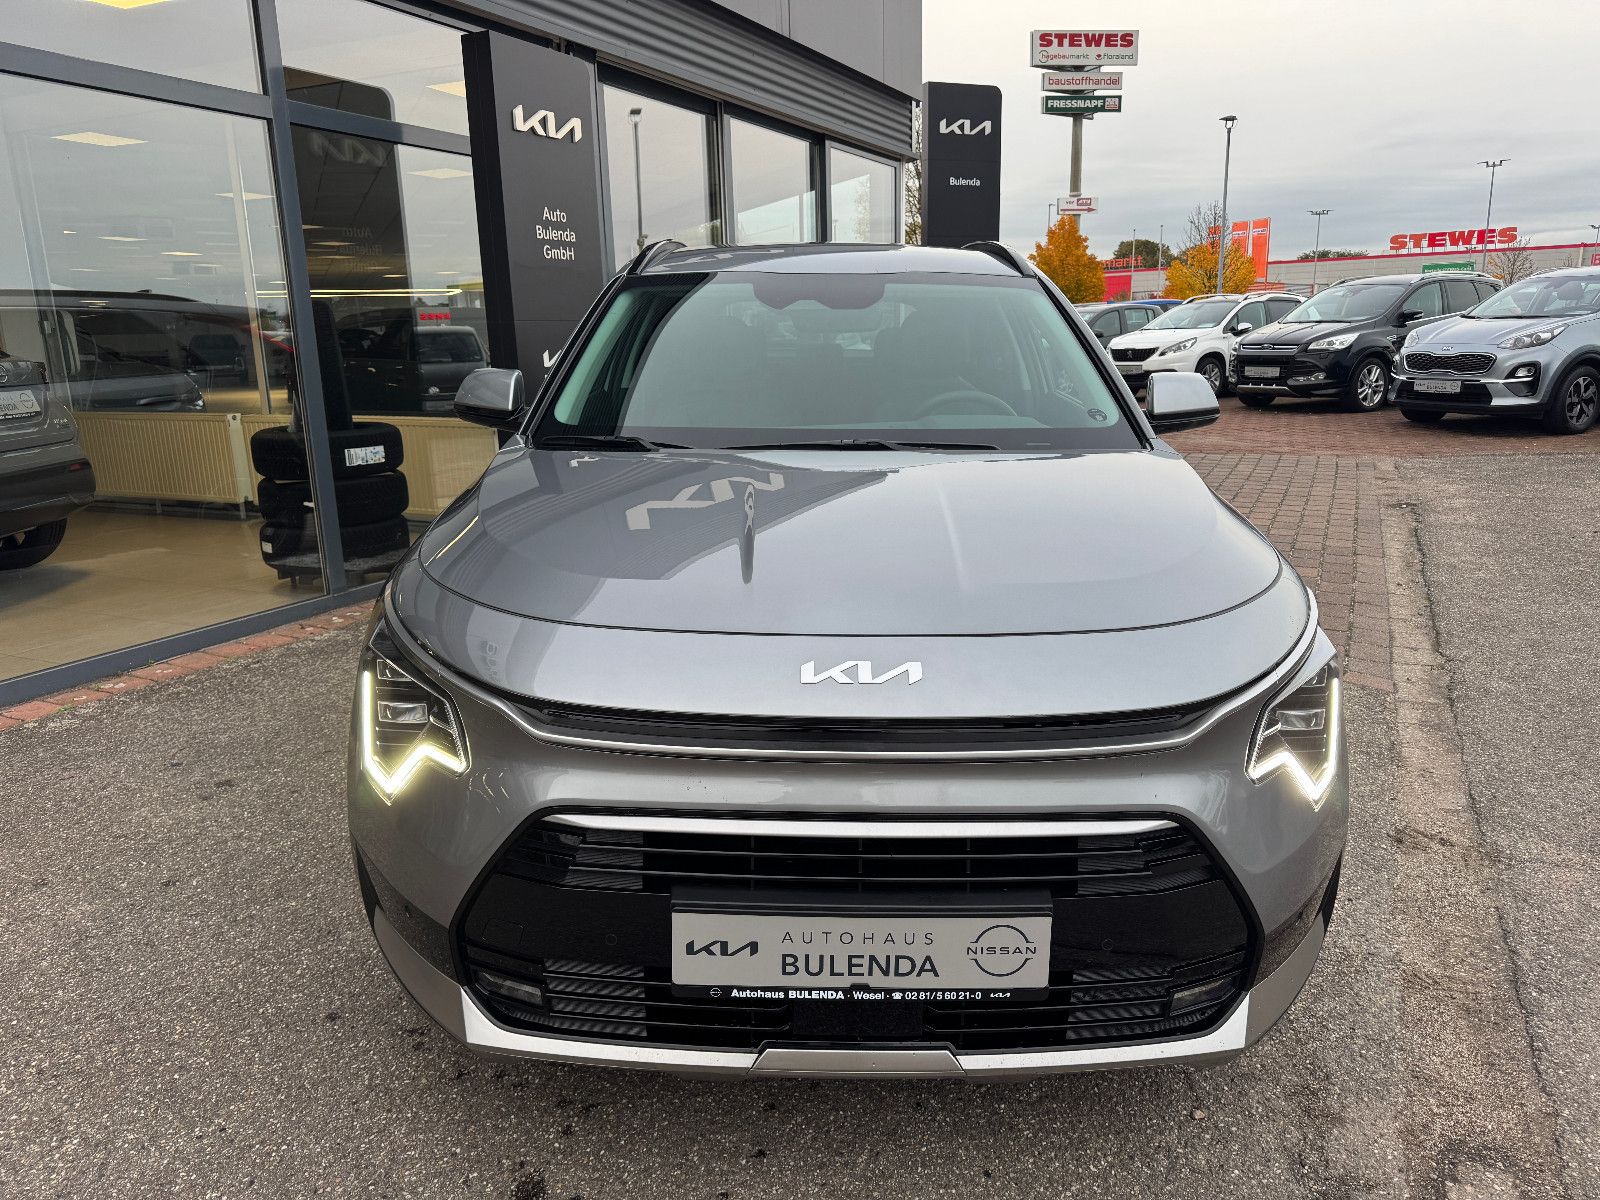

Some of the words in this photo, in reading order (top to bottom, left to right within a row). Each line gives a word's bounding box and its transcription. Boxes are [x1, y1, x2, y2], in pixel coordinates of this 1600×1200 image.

[1038, 32, 1134, 48] STEWES
[1041, 52, 1089, 61] hagebaumarkt
[1048, 76, 1120, 86] baustoffhandel
[1047, 99, 1104, 108] FRESSNAPF
[512, 104, 583, 143] KIA
[939, 117, 992, 136] KIA
[949, 176, 981, 187] Bulenda
[543, 206, 567, 223] Auto
[535, 225, 577, 243] Bulenda
[1389, 226, 1518, 251] STEWES
[543, 244, 576, 261] GmbH
[800, 660, 923, 685] KIA
[781, 931, 934, 946] AUTOHAUS
[686, 939, 759, 957] KIA
[966, 946, 1037, 956] NISSAN
[781, 953, 940, 978] BULENDA
[731, 988, 785, 999] Autohaus
[788, 989, 845, 999] BULENDA
[853, 990, 885, 1000] Wesel
